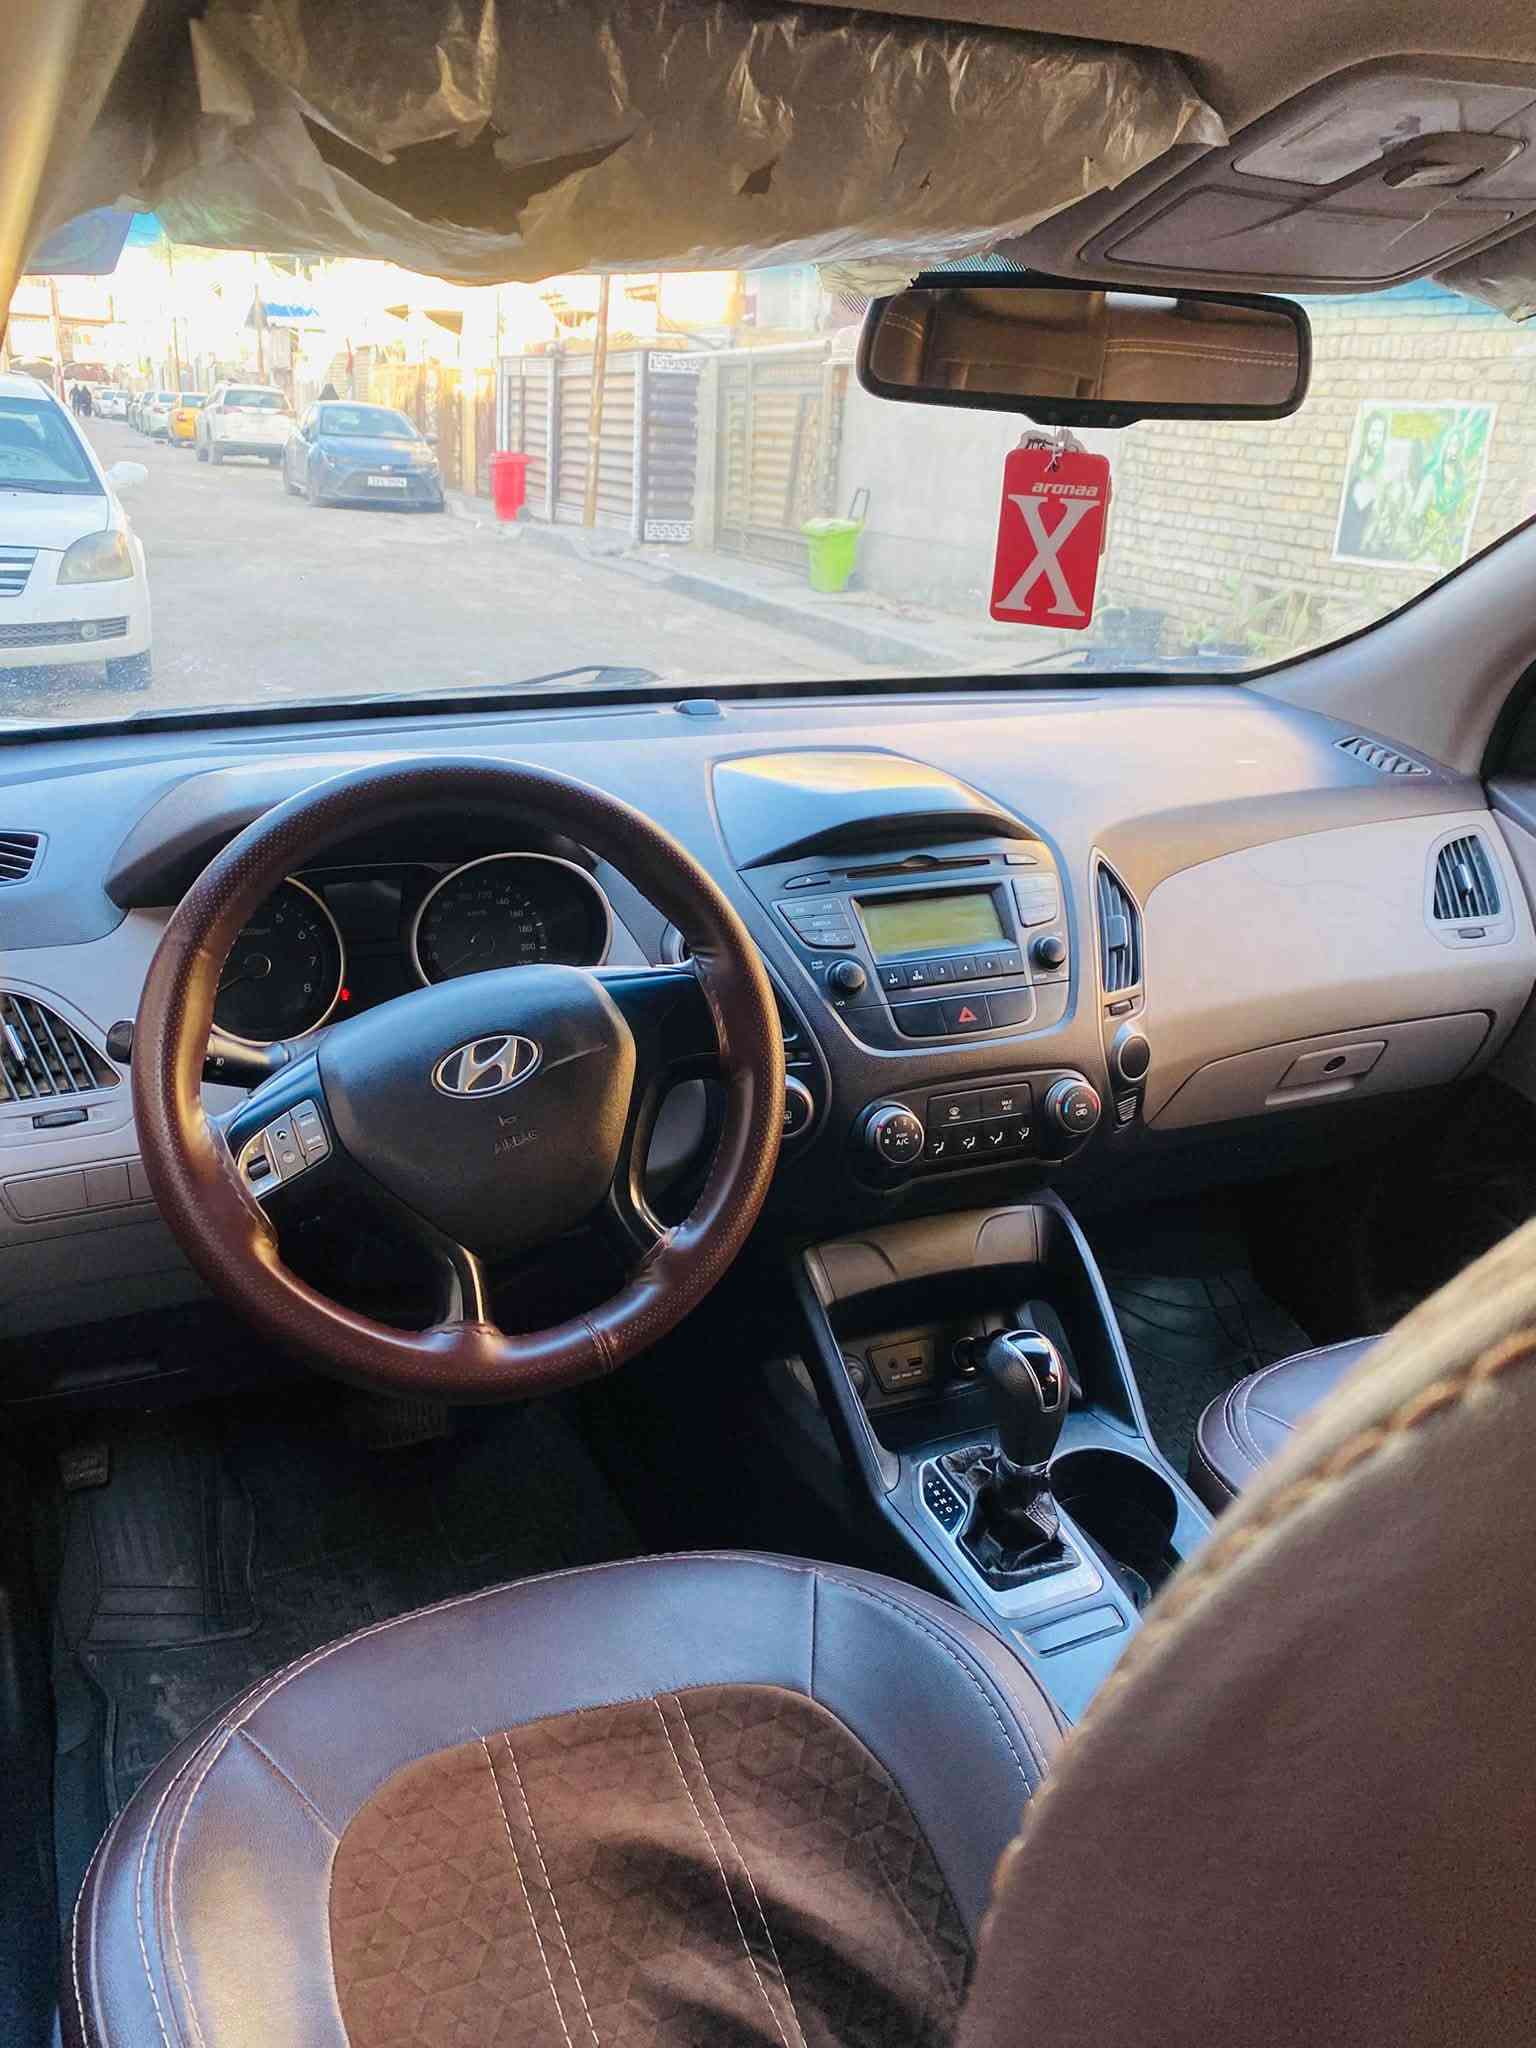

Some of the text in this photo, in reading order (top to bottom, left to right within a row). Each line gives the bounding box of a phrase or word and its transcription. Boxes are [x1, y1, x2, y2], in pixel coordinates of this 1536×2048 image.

[1031, 481, 1099, 497] aronaa
[994, 494, 1101, 617] X
[297, 930, 306, 940] 6
[308, 955, 318, 967] 7
[303, 983, 312, 993] 8
[895, 1137, 910, 1146] A/C
